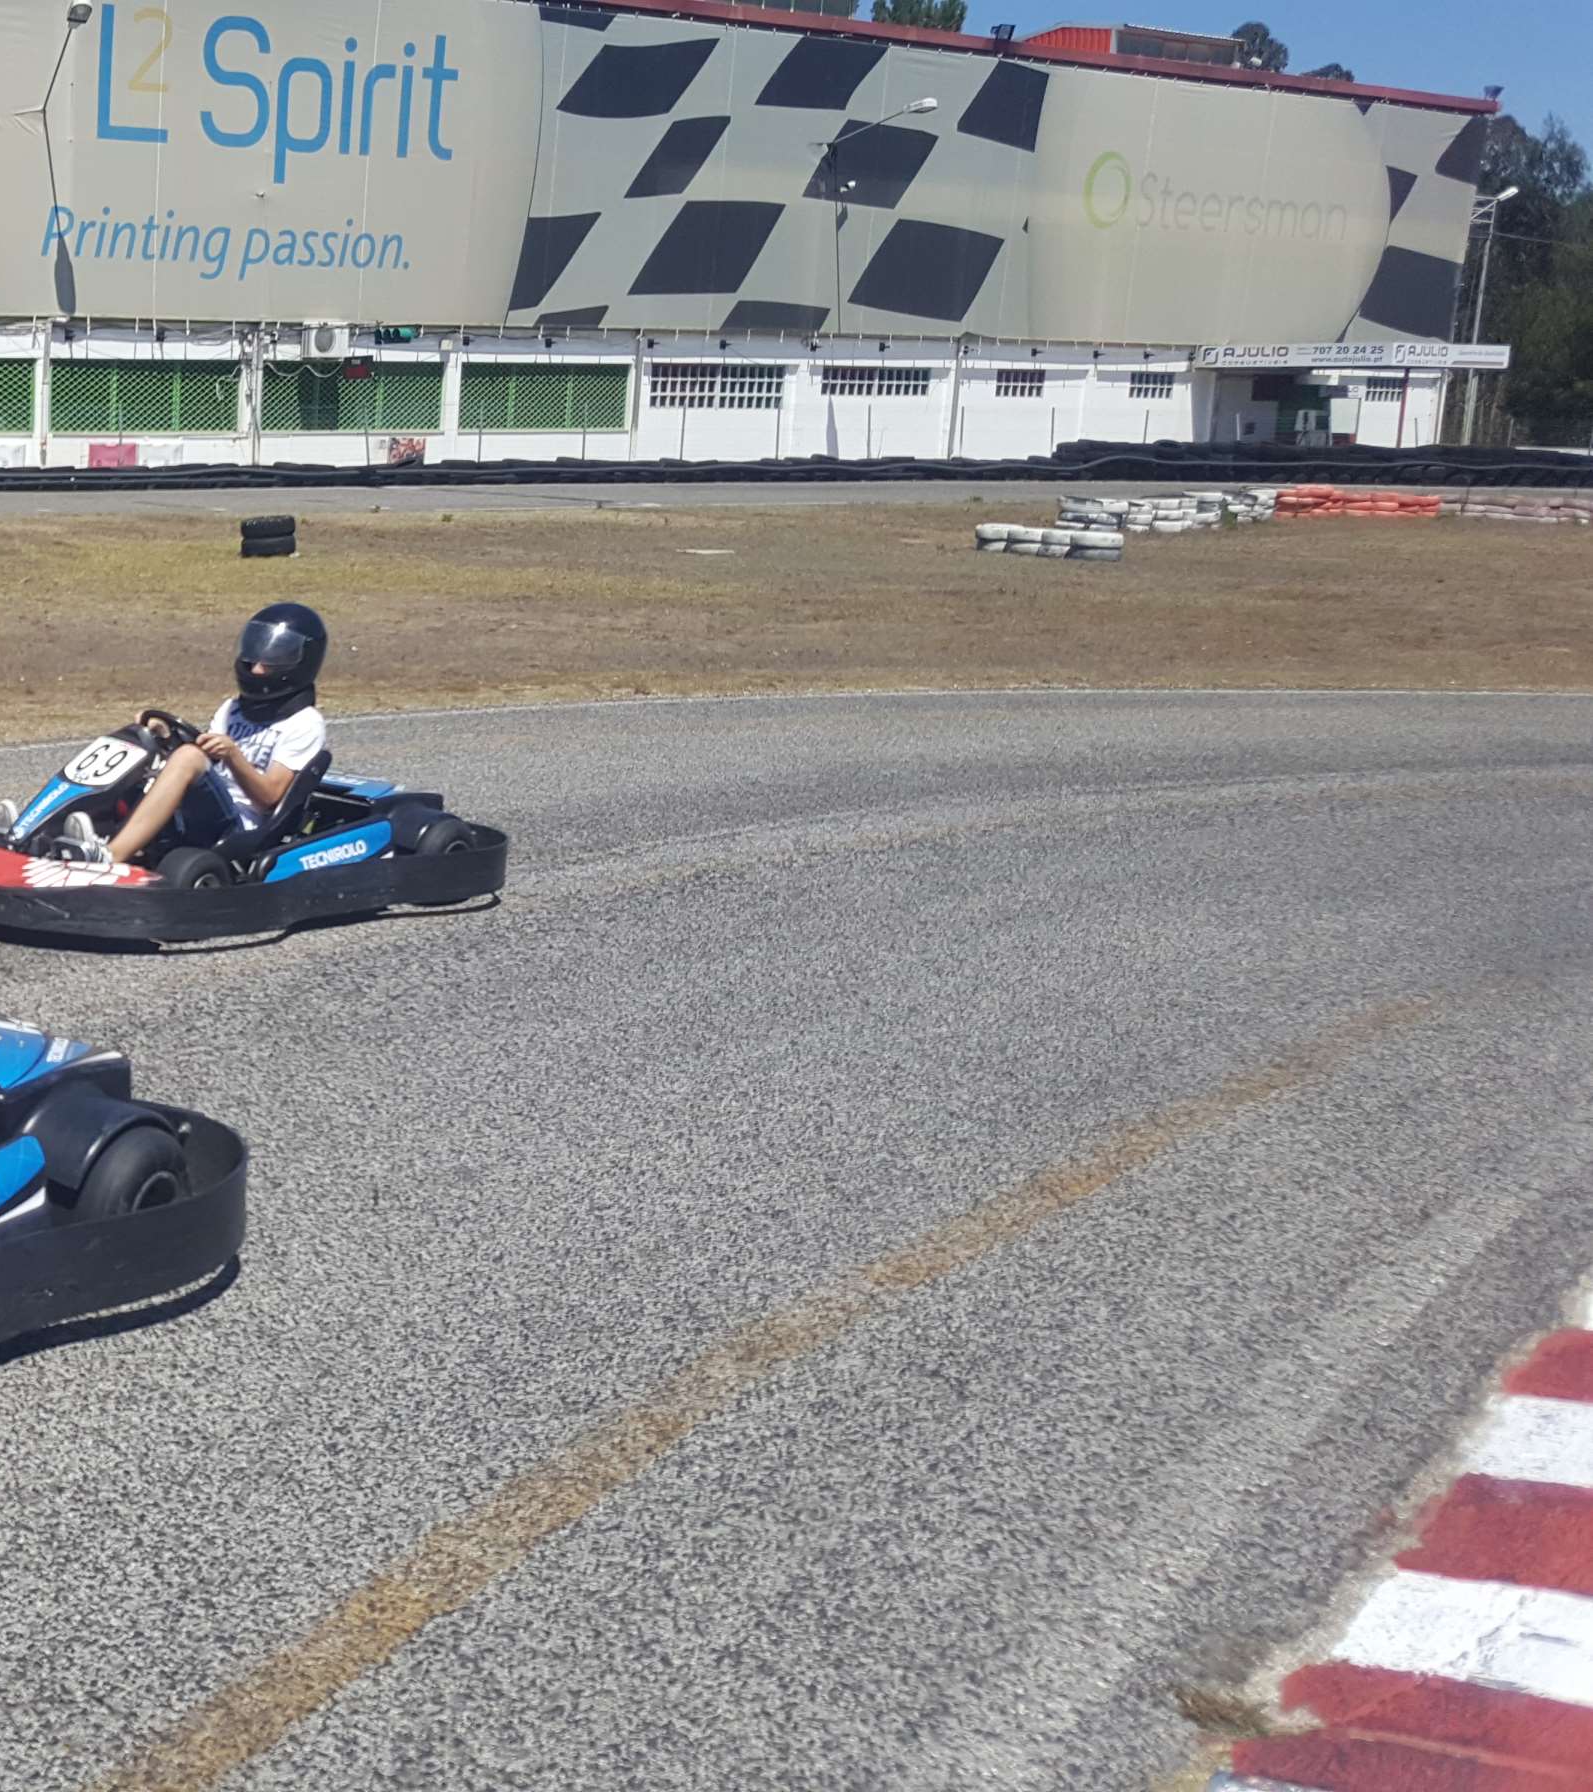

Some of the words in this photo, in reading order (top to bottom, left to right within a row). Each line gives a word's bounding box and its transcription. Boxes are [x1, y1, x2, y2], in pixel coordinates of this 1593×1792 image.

[200, 15, 459, 184] Spirit
[1135, 171, 1348, 240] Steersman
[41, 205, 231, 280] Printing
[238, 217, 410, 281] passion.
[1312, 346, 1332, 355] 707
[1335, 346, 1350, 355] 20
[1353, 346, 1367, 355] 24
[1370, 346, 1385, 355] 25
[76, 743, 128, 778] 69
[299, 839, 367, 871] TECNIROLO
